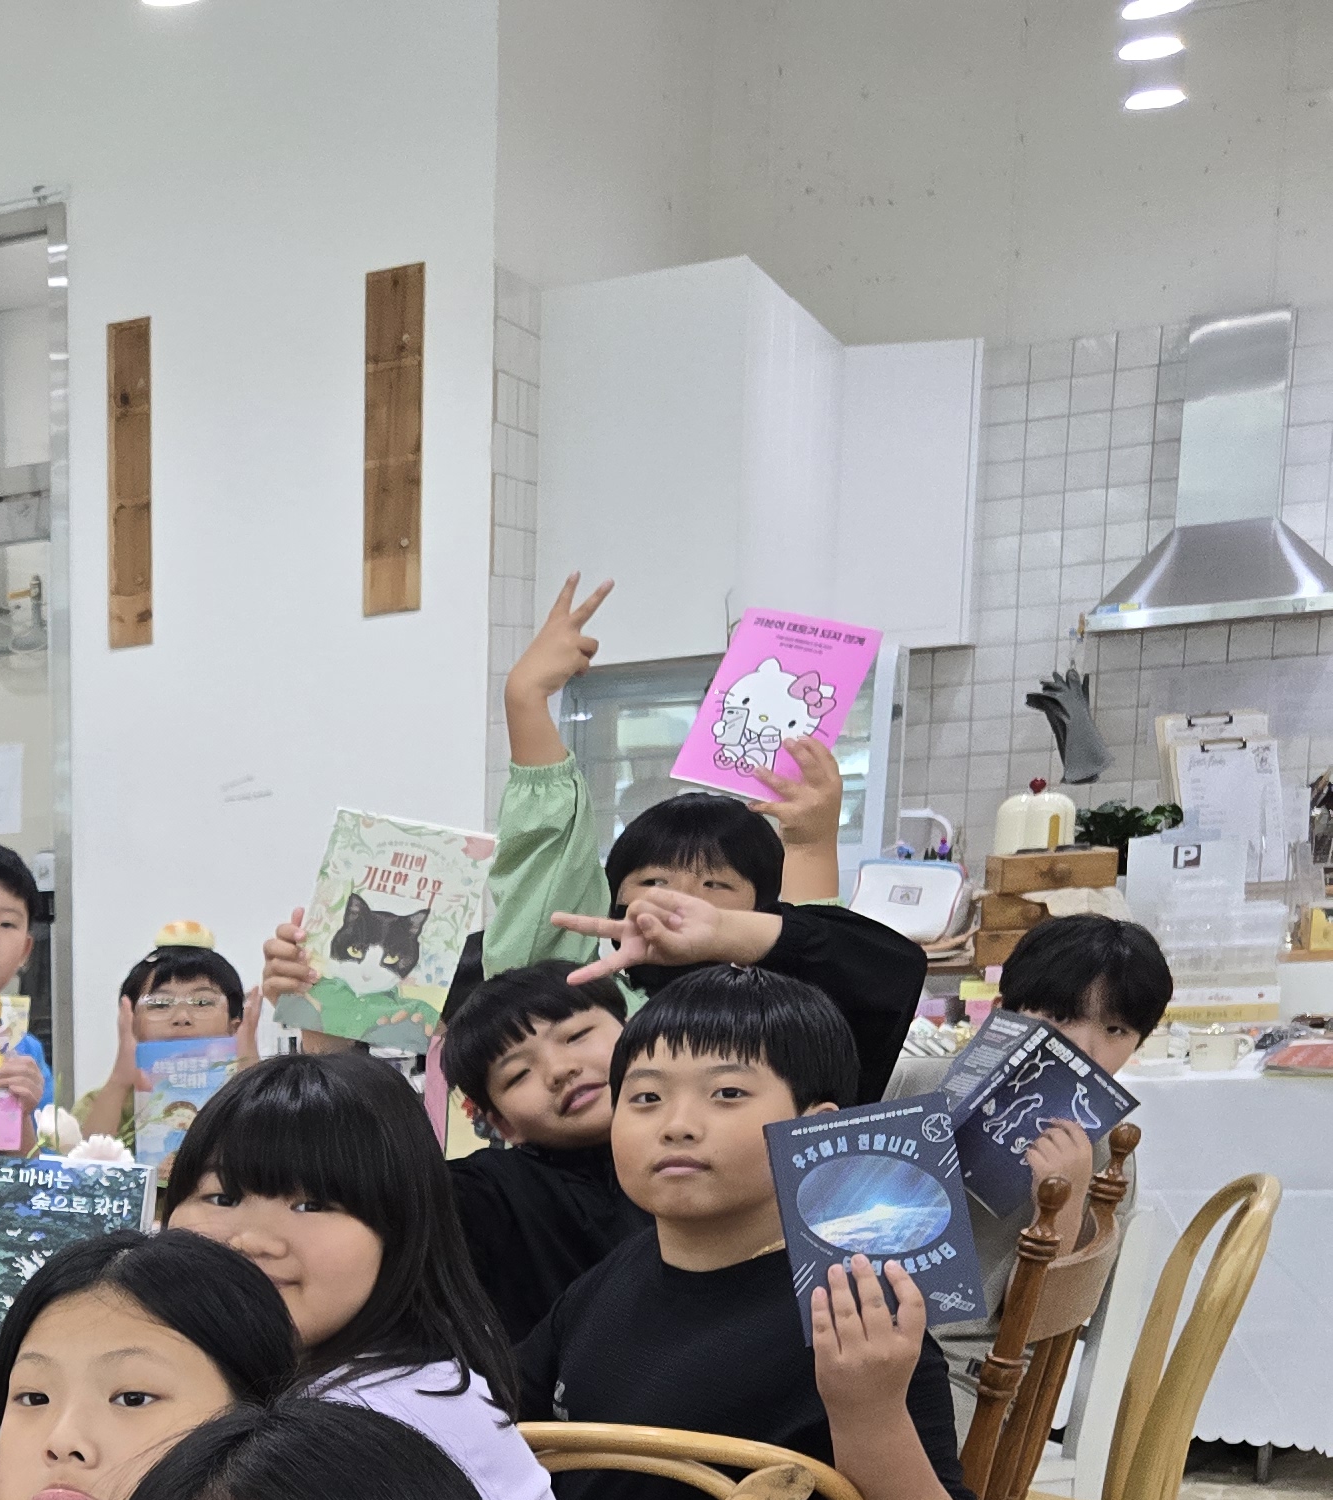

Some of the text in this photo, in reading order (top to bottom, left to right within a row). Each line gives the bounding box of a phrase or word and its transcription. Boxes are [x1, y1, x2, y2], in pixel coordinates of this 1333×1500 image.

[1177, 846, 1199, 869] P
[19, 1168, 74, 1190] 마녀는
[31, 1192, 132, 1218] 숲으로 갔다
